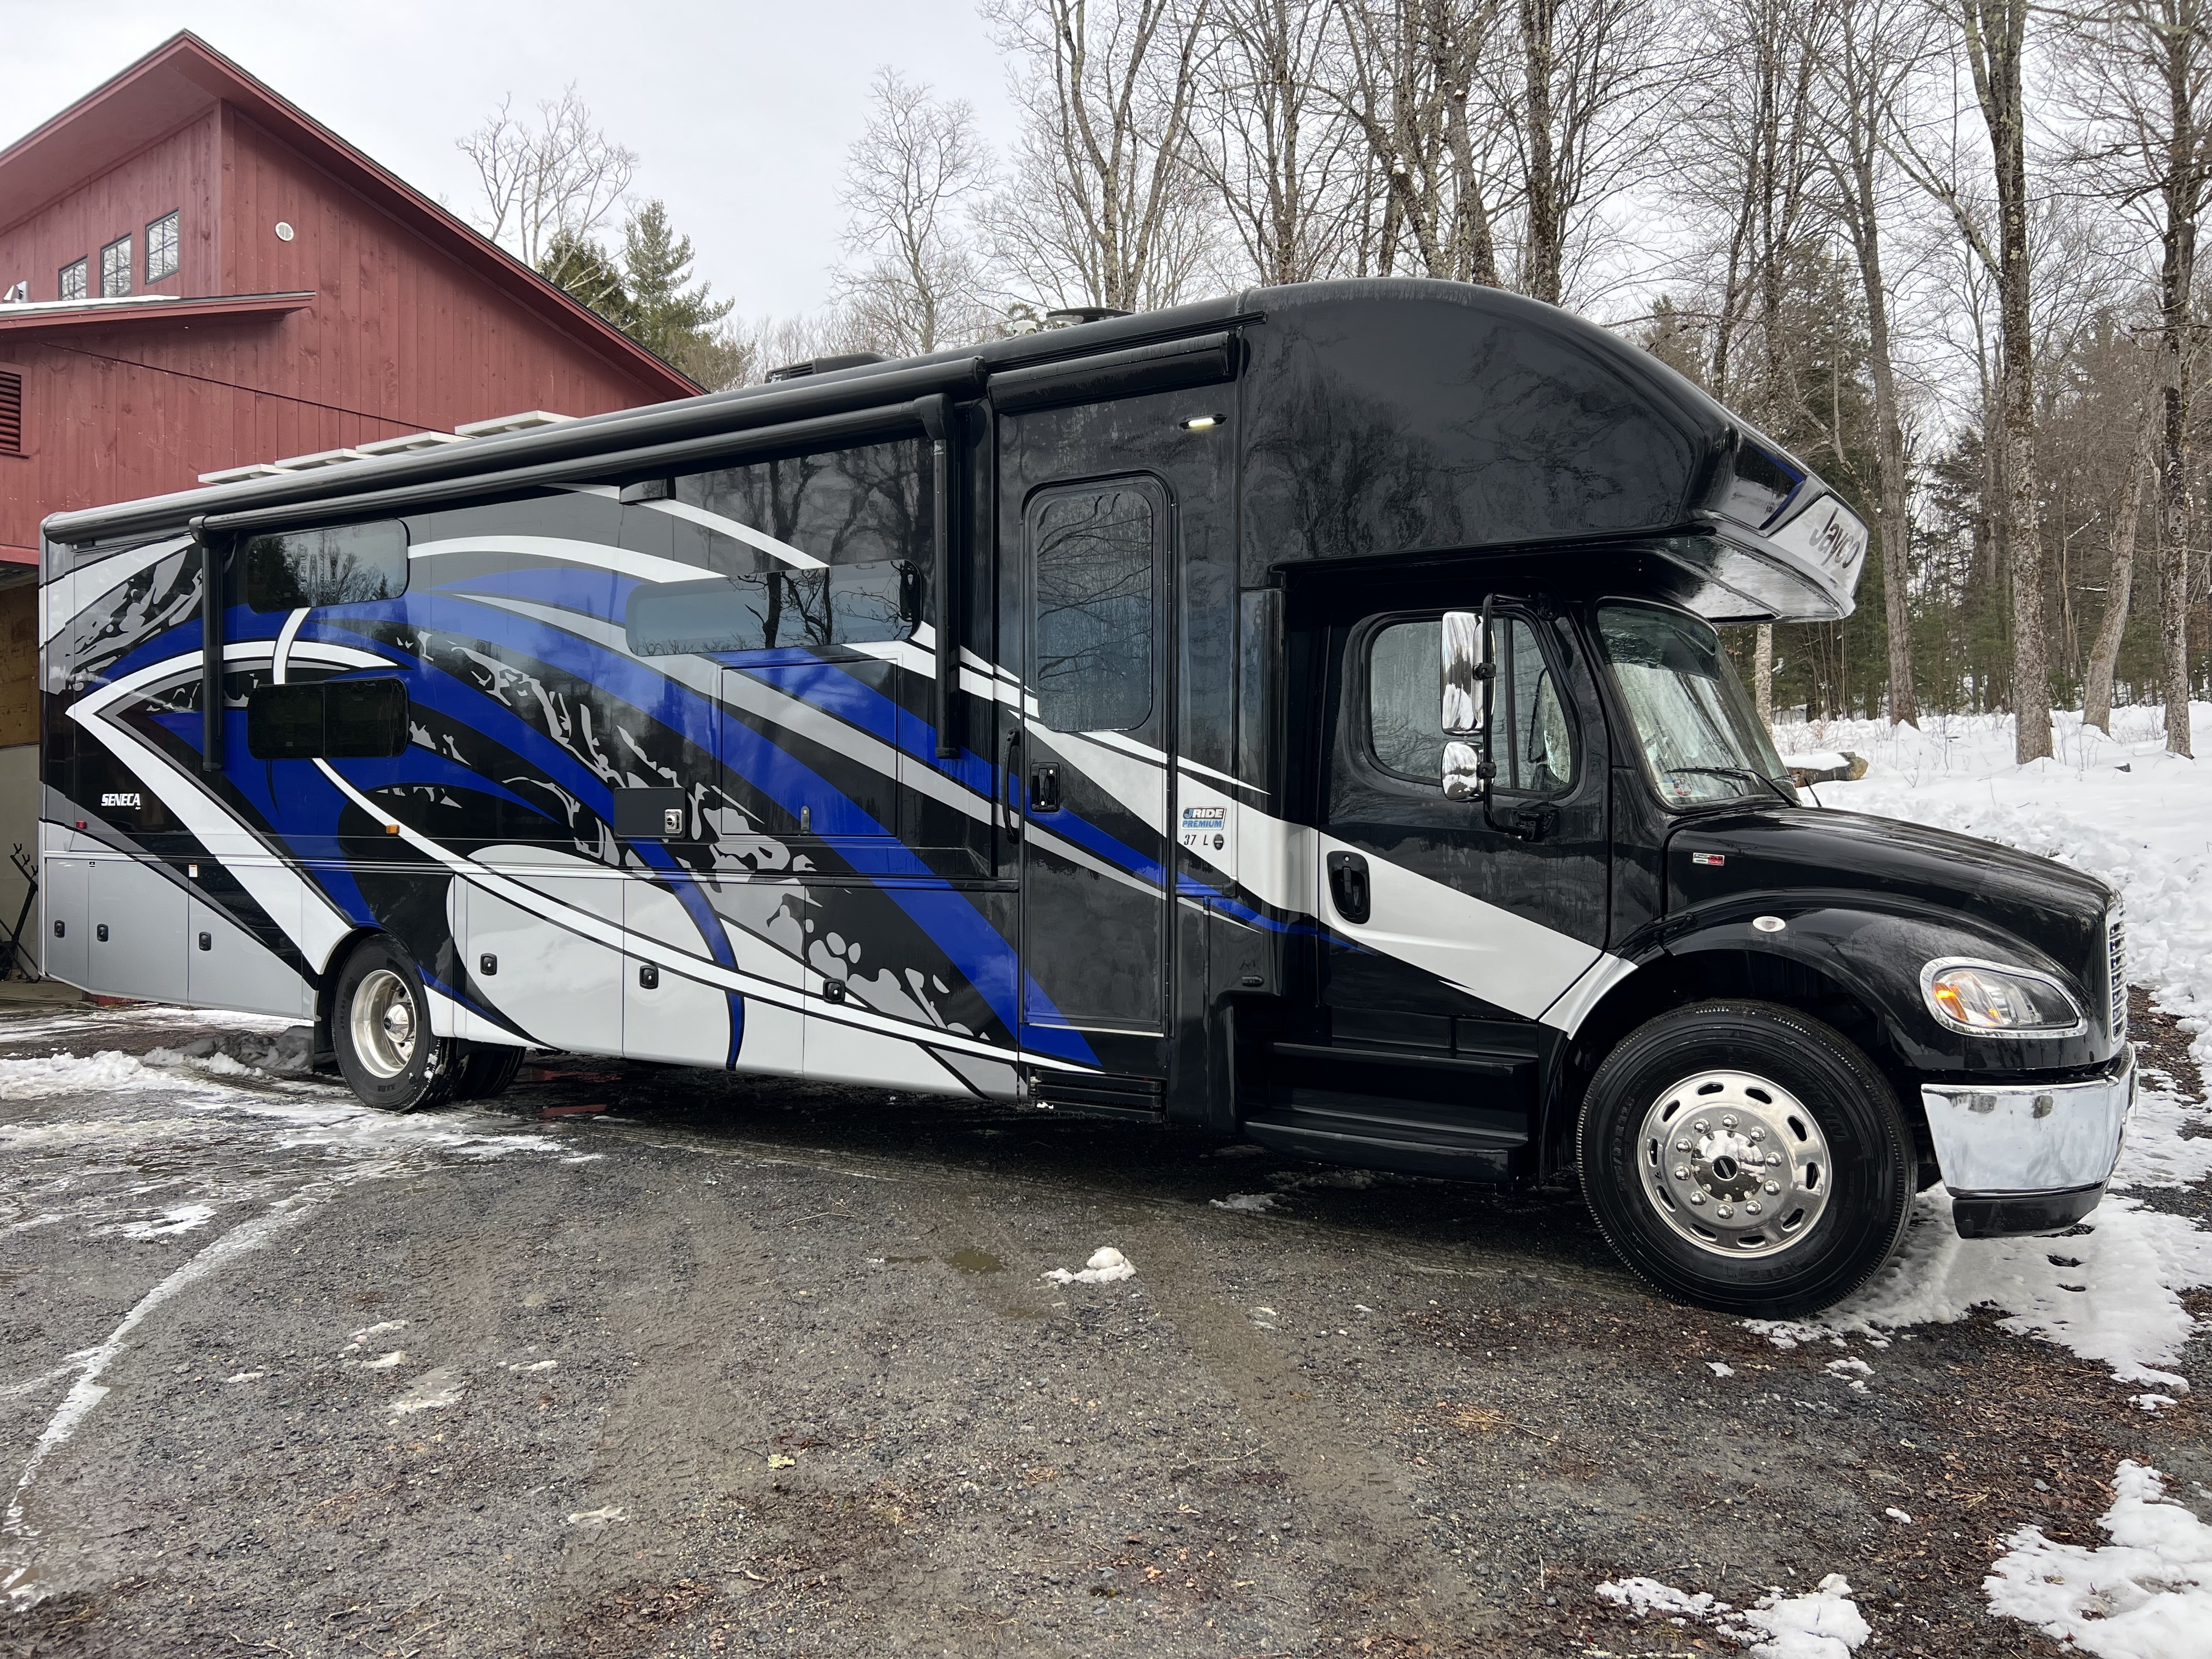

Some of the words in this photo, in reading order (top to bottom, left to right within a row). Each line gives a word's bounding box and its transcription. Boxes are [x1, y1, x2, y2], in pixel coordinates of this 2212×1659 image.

[1809, 507, 1860, 569] Jayco
[100, 793, 141, 806] SENECA
[1184, 809, 1223, 818] JRIDE
[1184, 834, 1197, 845] 37
[1203, 835, 1208, 845] L
